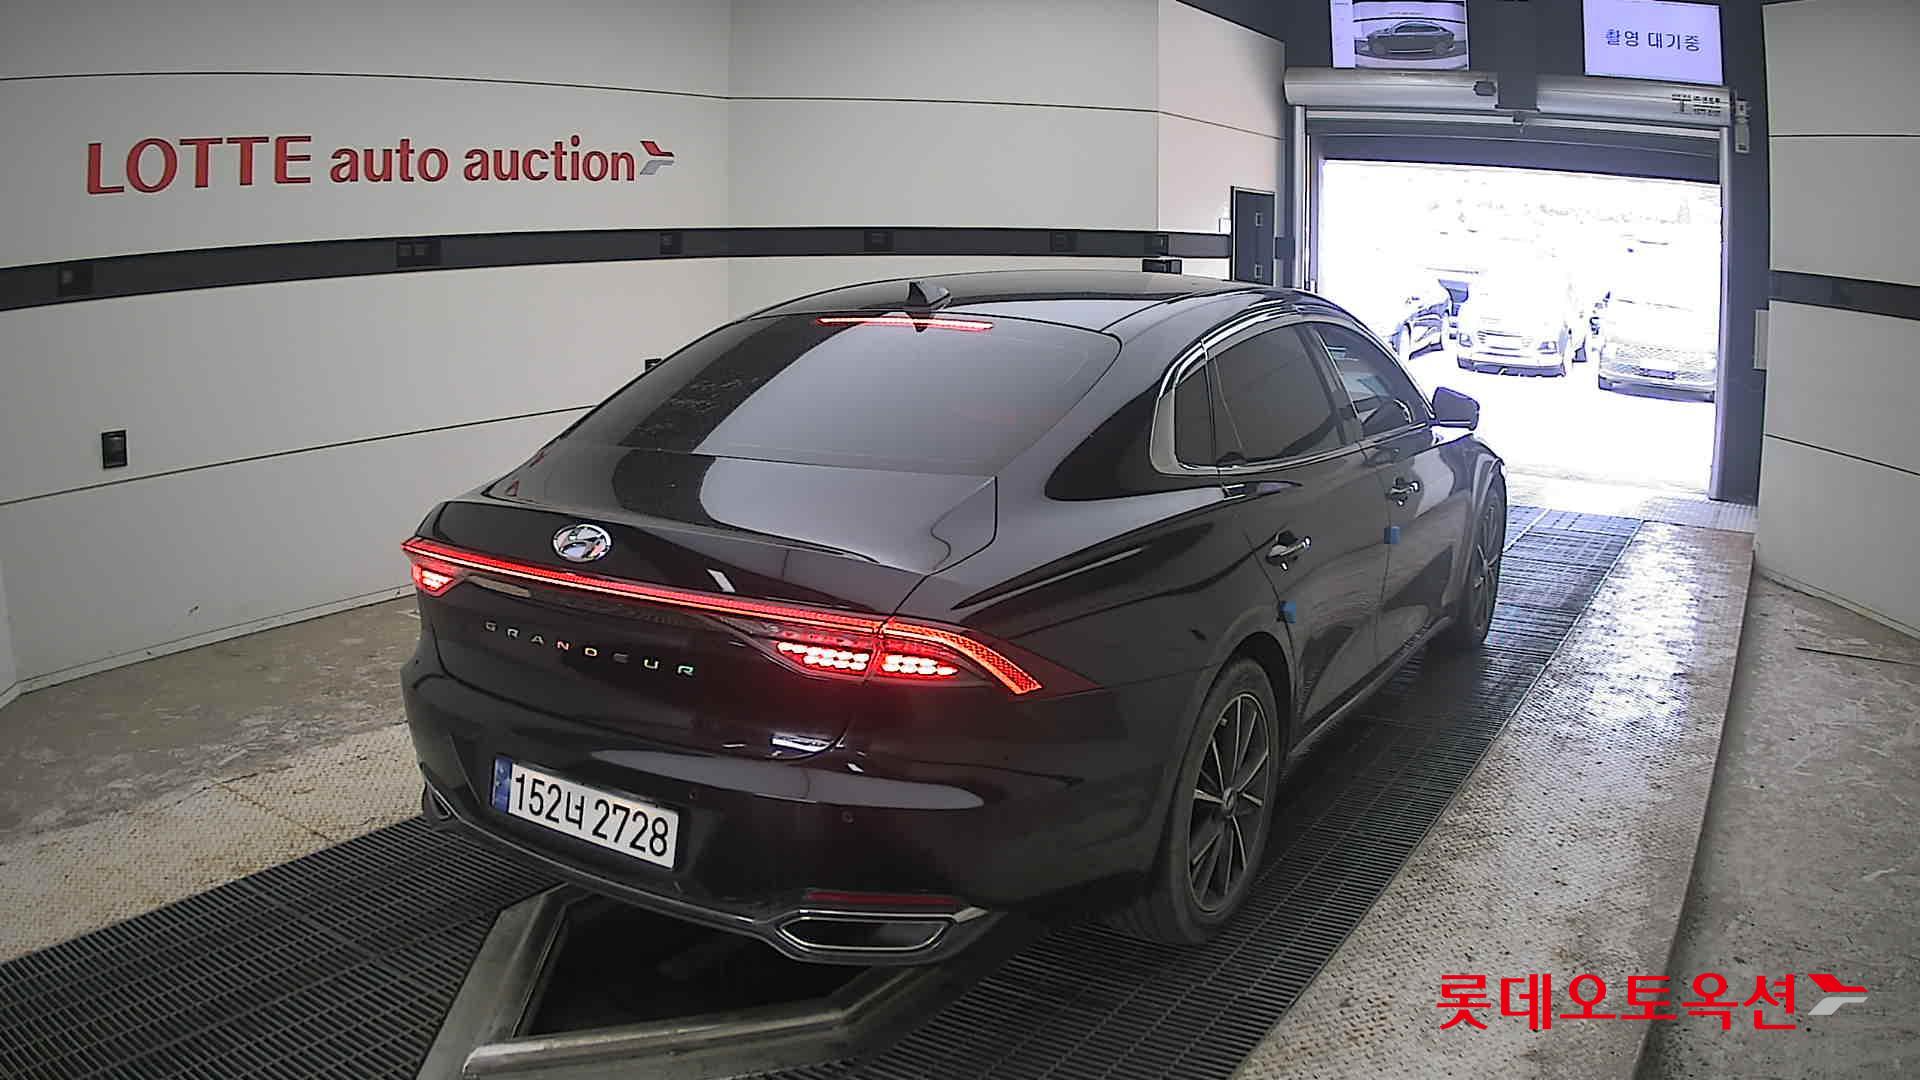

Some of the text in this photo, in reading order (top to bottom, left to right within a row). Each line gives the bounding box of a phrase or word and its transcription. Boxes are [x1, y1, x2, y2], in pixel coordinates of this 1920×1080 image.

[1648, 32, 1700, 52] 대기중
[86, 134, 636, 194] LOTTE auto auction
[484, 621, 694, 677] GRANDEUR
[514, 773, 670, 857] 152너 2728
